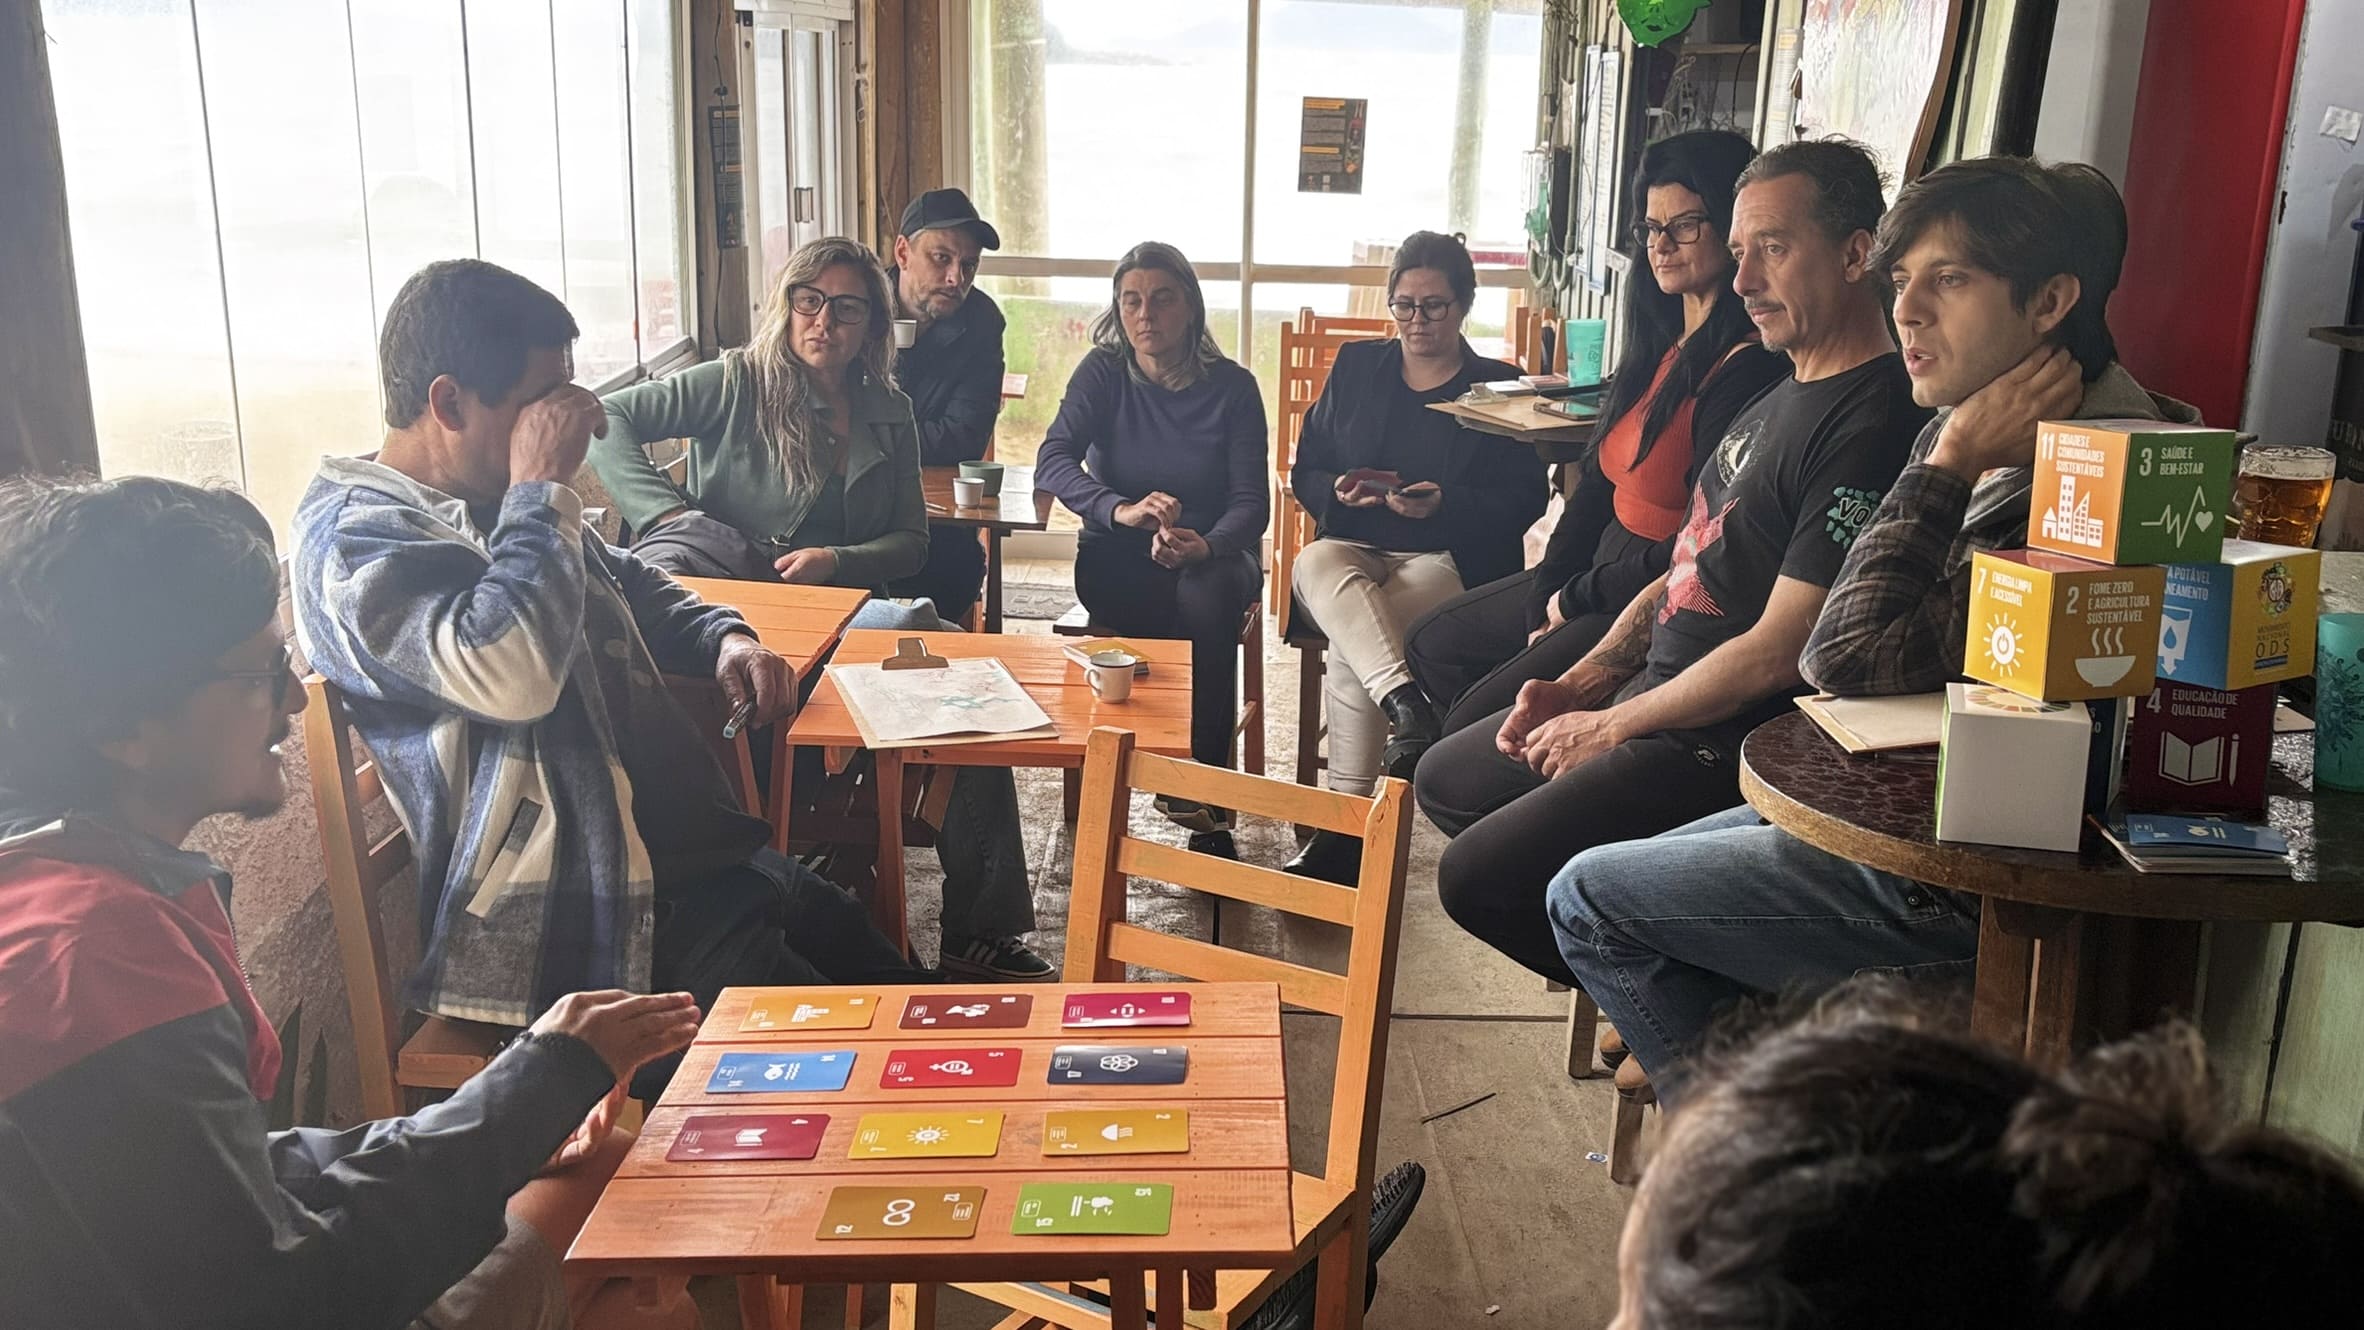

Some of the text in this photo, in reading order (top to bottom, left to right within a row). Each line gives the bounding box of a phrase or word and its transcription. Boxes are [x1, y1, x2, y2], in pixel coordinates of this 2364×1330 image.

[2041, 432, 2055, 461] 11
[2161, 445, 2194, 460] SAÚDE E
[2139, 447, 2153, 476] 3
[2160, 462, 2204, 476] BEM-ESTAR
[1978, 567, 1987, 594] 7
[2175, 567, 2210, 584] POTÁVEL
[2088, 580, 2134, 595] FOME ZERO
[2066, 585, 2080, 614] 2
[2087, 595, 2150, 610] E AGRICULTURA
[2086, 609, 2144, 624] SUSTENTÁVEL
[2146, 687, 2162, 713] 4
[2172, 688, 2240, 706] EDUCAÇÃO DE
[2171, 703, 2228, 720] QUALIDADE
